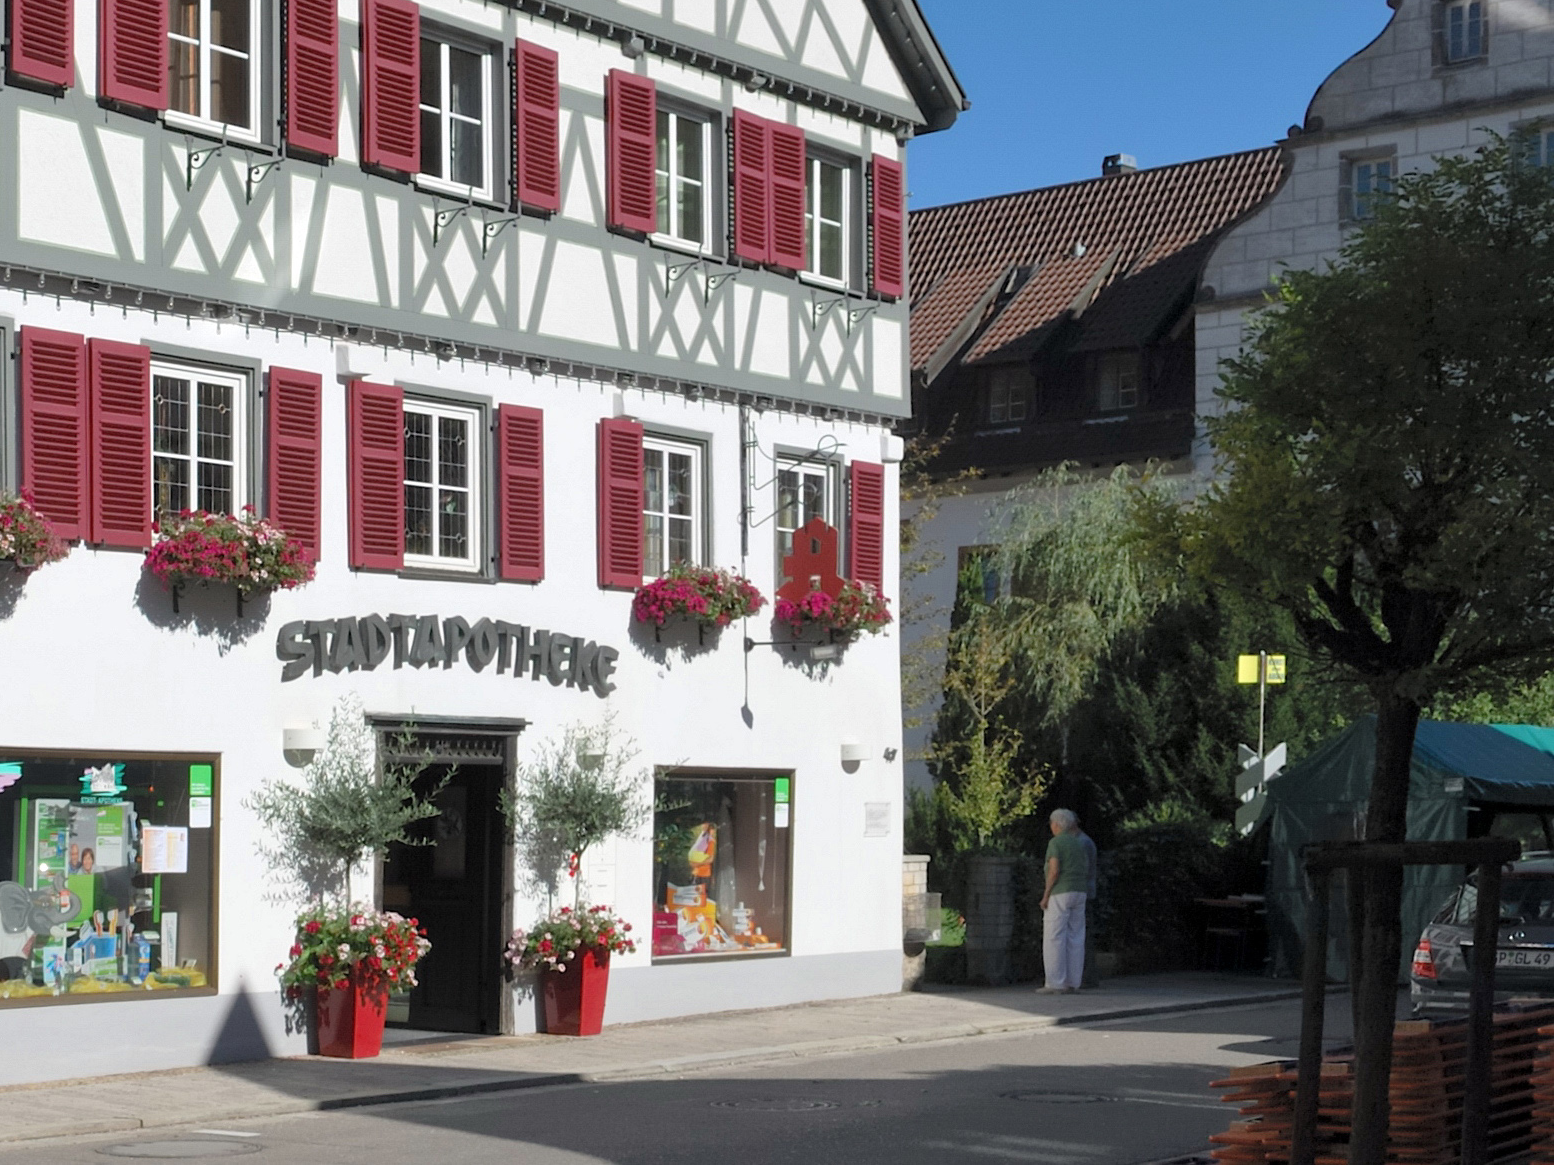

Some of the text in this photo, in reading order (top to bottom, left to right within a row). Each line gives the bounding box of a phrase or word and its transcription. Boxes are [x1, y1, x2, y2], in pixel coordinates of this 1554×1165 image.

[275, 612, 620, 699] STADTAPOTHEKE
[1515, 952, 1531, 965] GL
[1534, 953, 1551, 965] 49
